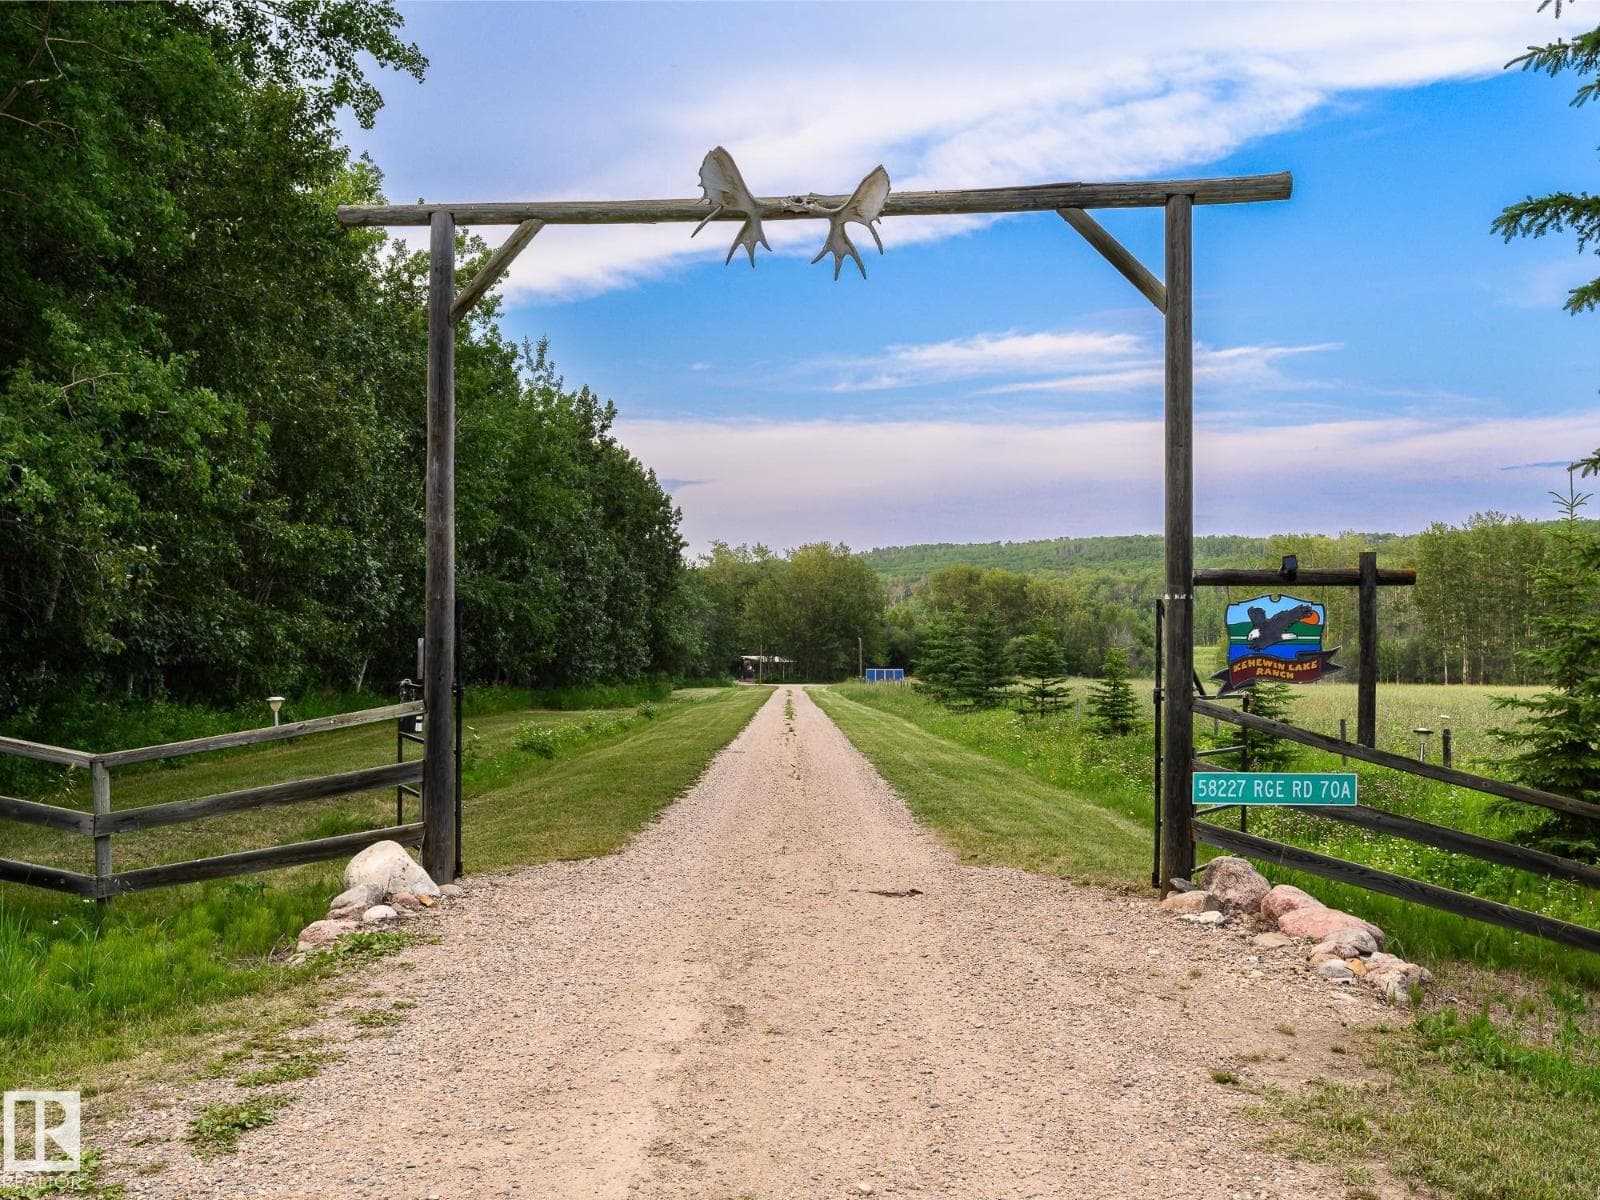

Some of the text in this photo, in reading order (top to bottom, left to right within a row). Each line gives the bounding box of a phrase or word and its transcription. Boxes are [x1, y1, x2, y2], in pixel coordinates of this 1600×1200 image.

[1233, 659, 1318, 673] KEHEWIN LAKE
[1255, 667, 1294, 679] RANCH
[1198, 779, 1351, 799] 58227 RGE RD 70A
